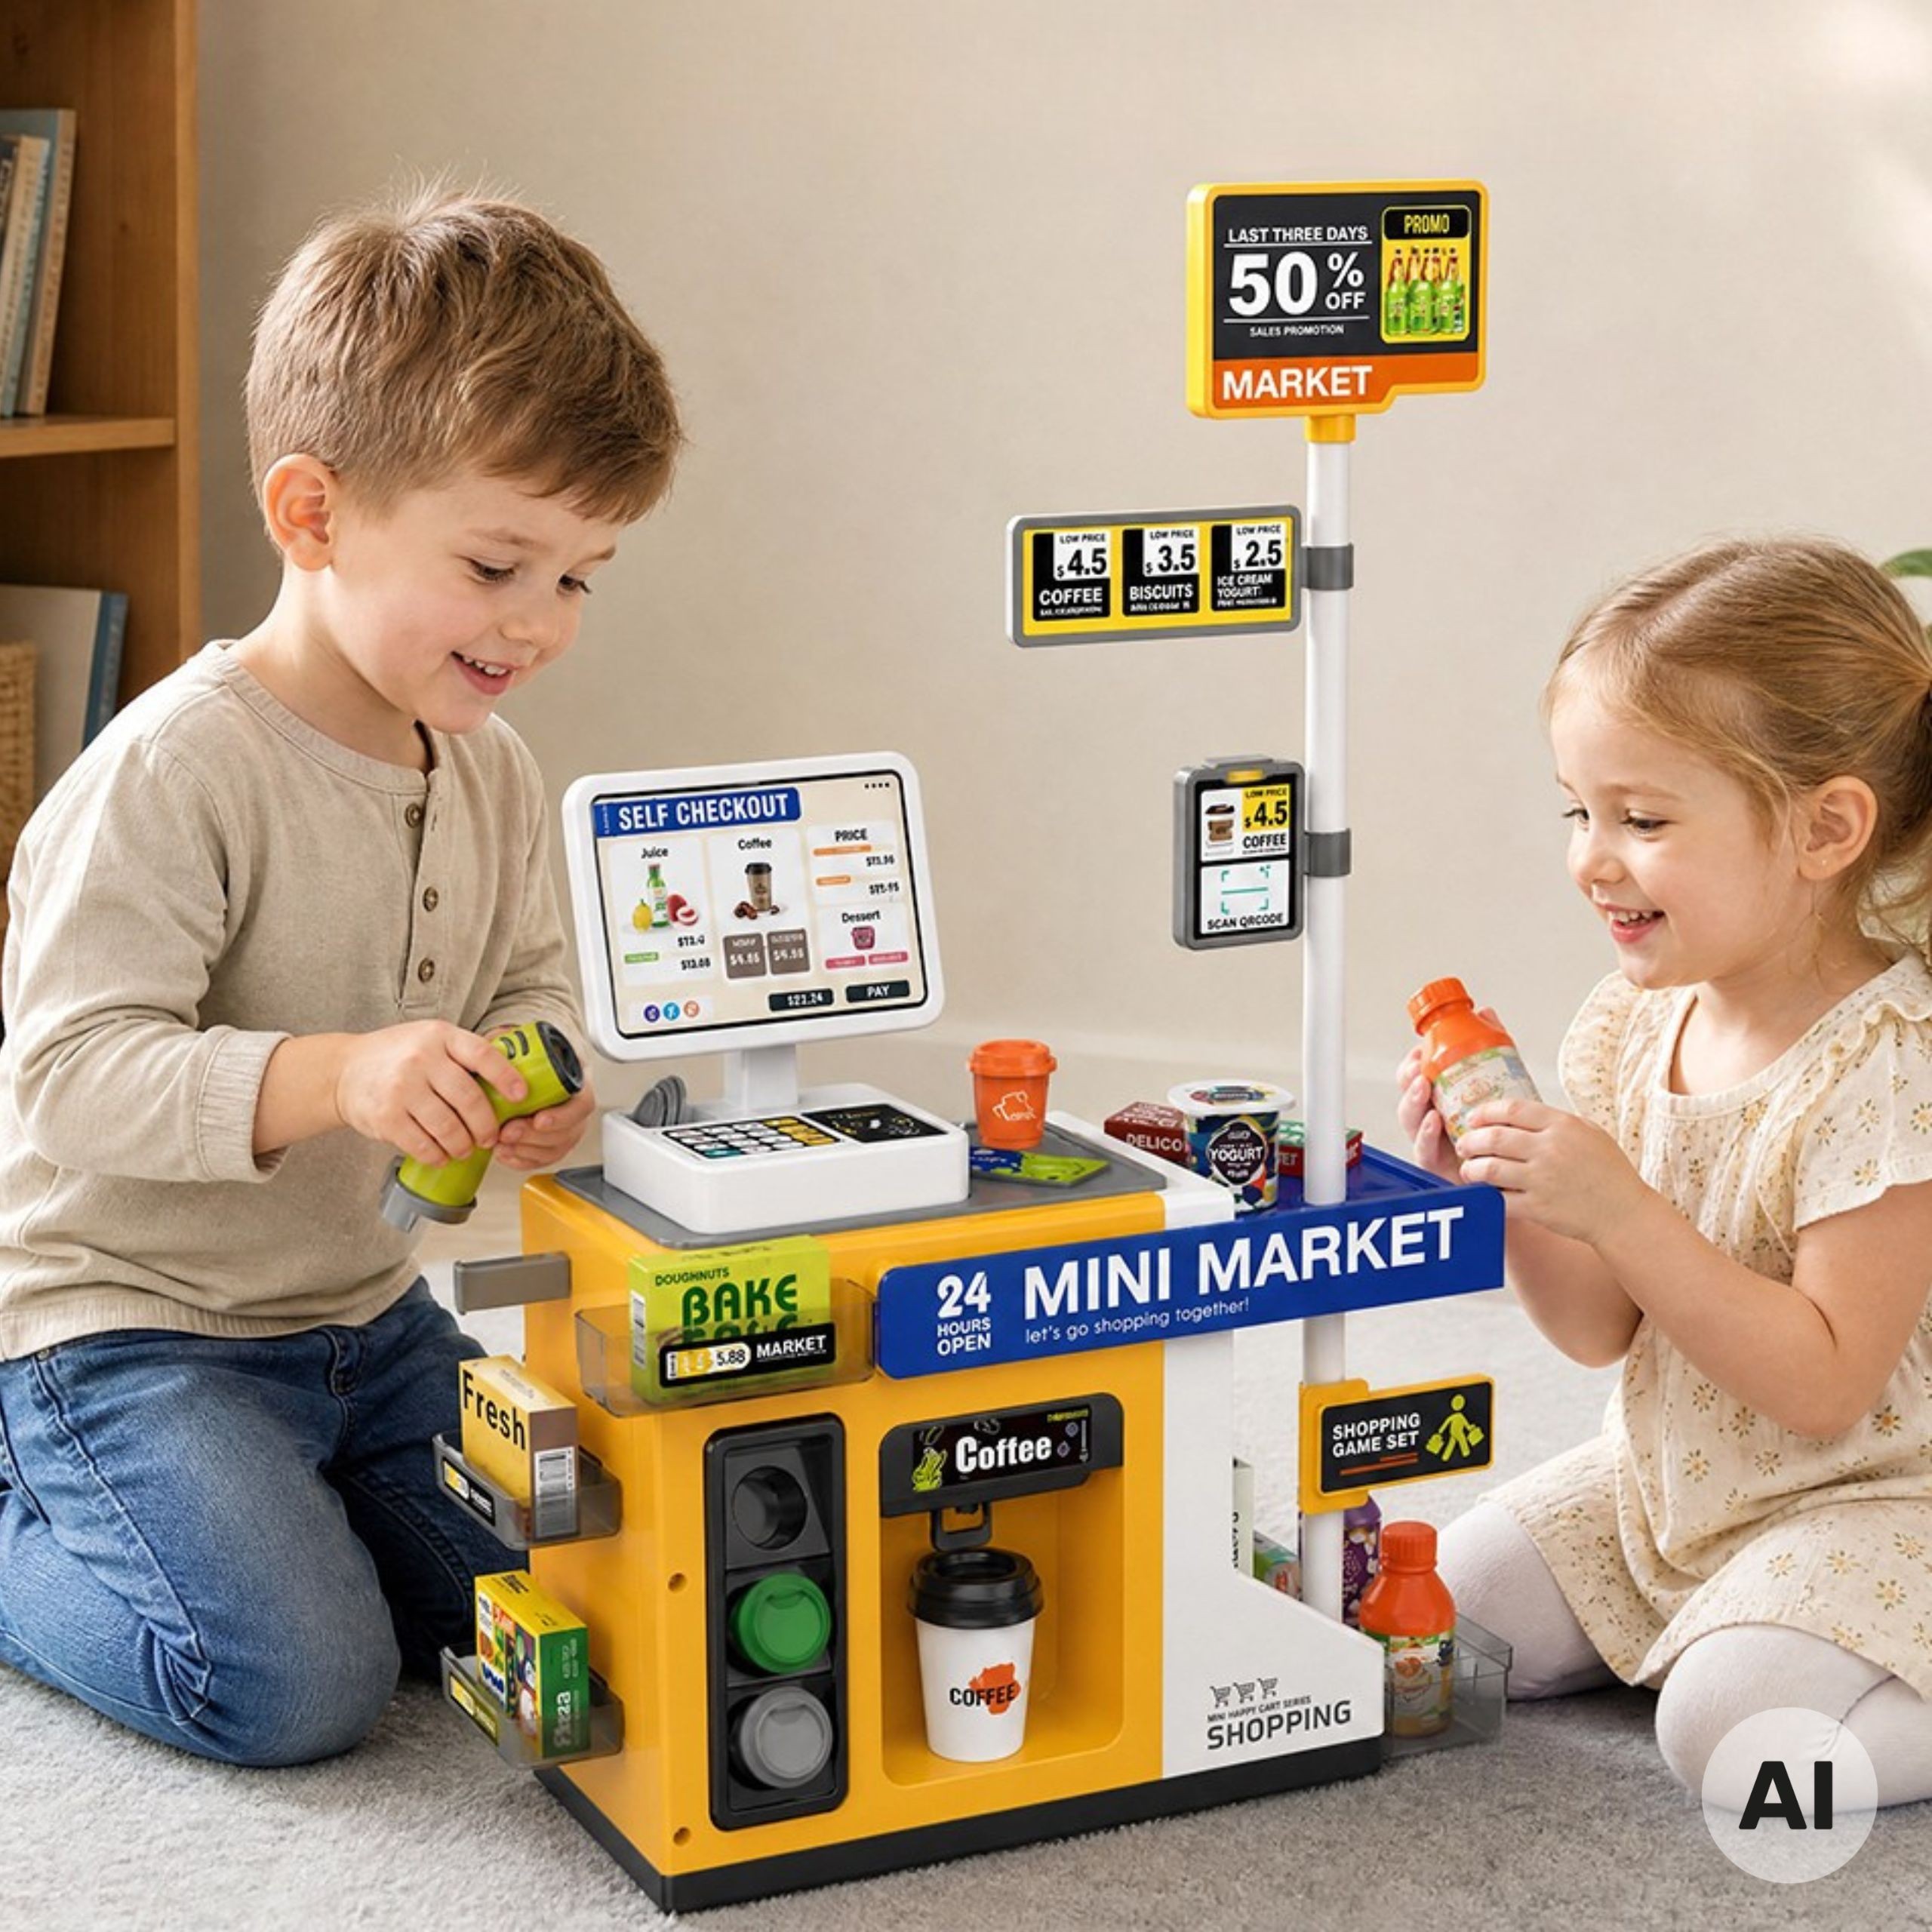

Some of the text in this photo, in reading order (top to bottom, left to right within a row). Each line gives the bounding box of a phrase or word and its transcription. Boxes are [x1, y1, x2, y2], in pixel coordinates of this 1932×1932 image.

[1404, 214, 1450, 234] PROMO
[1229, 226, 1368, 243] LAST THREE DAYS
[1229, 251, 1364, 316] 50 %
[1325, 291, 1367, 310] OFF
[1250, 323, 1344, 337] SALES PROMOTION
[1223, 365, 1372, 400] MARKET
[1060, 533, 1106, 544] LOW PRICE
[1150, 528, 1194, 540] LOW PRICE
[1236, 524, 1281, 536] LOW PRICE
[1067, 547, 1107, 576] 4.5
[1158, 543, 1195, 572] 3.5
[1245, 540, 1281, 567] 2.5
[1217, 573, 1272, 586] ICE CREAM
[1039, 586, 1103, 605] COFFEE
[1129, 583, 1193, 601] BISCUITS
[1217, 586, 1260, 598] YOGURT
[619, 803, 668, 830] SELF
[675, 793, 789, 824] CHECKOUT
[1254, 801, 1287, 826] 4.5
[738, 838, 772, 851] Coffee
[835, 829, 867, 841] PRICE
[1243, 833, 1287, 848] COFFEE
[641, 846, 669, 859] Juice
[841, 910, 881, 924] Dessert
[1208, 912, 1284, 930] SCAN QRCODE
[867, 985, 890, 997] PAY
[1126, 1134, 1182, 1151] DELICO
[1209, 1146, 1263, 1161] YOGURT
[1025, 1207, 1464, 1320] MINI MARKET
[655, 1267, 730, 1286] DOUGHNUTS
[682, 1275, 798, 1326] BAKE
[937, 1272, 992, 1319] 24
[937, 1317, 991, 1338] HOURS
[1026, 1297, 1250, 1344] let's go shopping together!
[757, 1335, 827, 1358] MARKET
[937, 1334, 991, 1356] OPEN
[463, 1370, 526, 1451] Fresh
[1333, 1412, 1421, 1441] SHOPPING
[956, 1435, 1052, 1472] Coffee
[1333, 1431, 1419, 1457] GAME SET
[950, 1684, 1016, 1706] COFFEE
[1208, 1696, 1312, 1722] MINI HAPPY CART SERIES
[1208, 1700, 1351, 1750] SHOPPING
